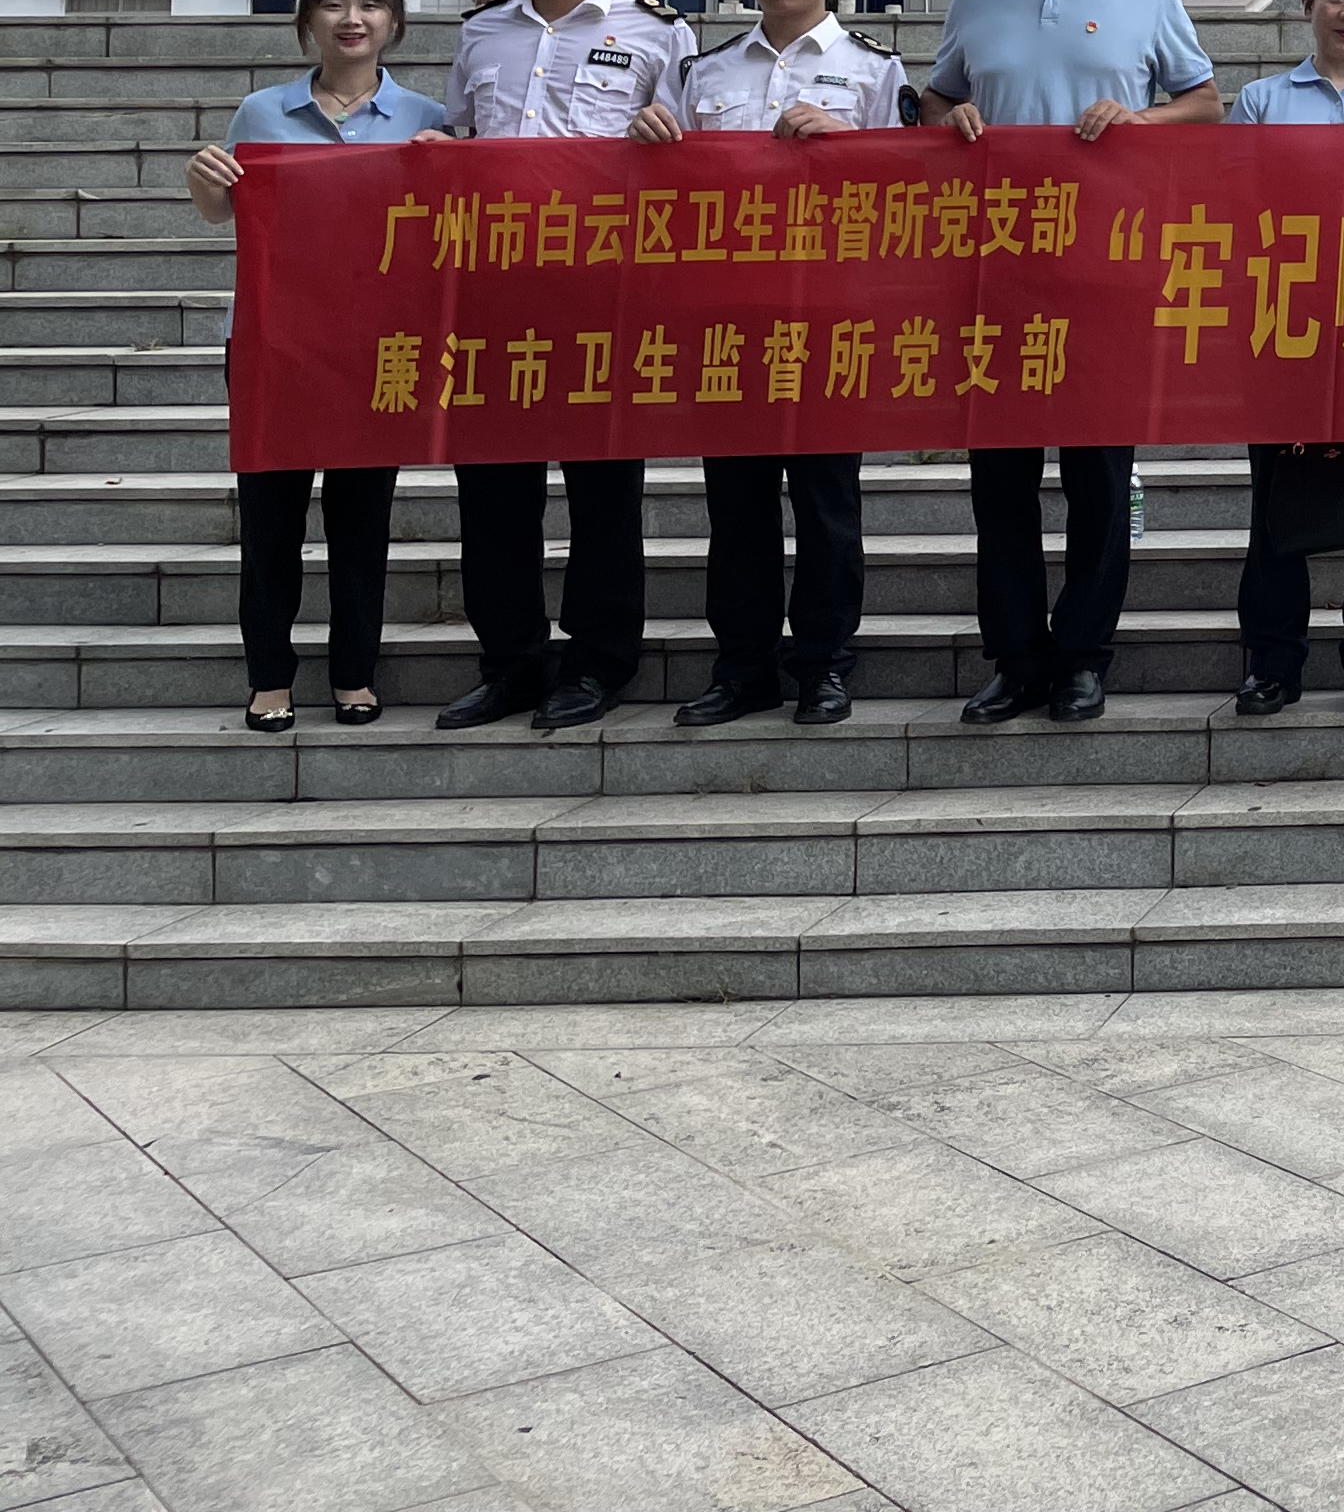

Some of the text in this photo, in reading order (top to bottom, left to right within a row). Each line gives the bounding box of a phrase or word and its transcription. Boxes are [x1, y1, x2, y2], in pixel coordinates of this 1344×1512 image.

[592, 51, 629, 66] 448489
[378, 177, 1080, 275] 广州市白云区卫生监督所党支部
[370, 313, 1071, 414] 廉江市卫生监督所党支部
